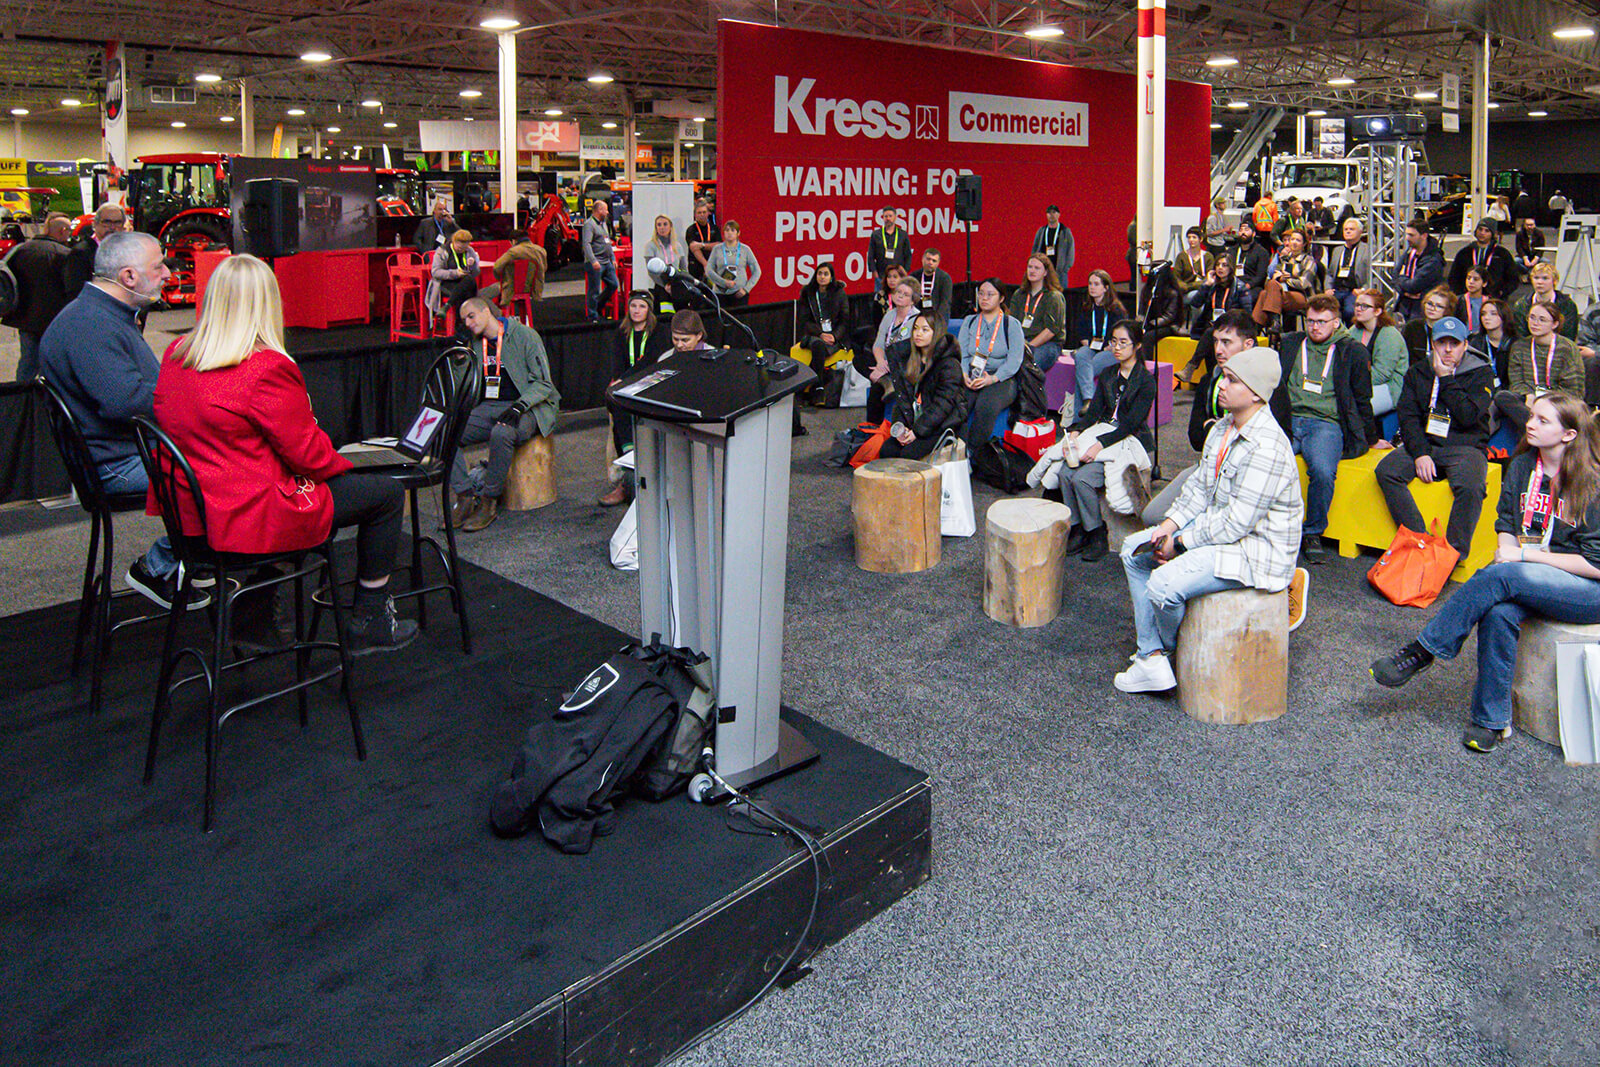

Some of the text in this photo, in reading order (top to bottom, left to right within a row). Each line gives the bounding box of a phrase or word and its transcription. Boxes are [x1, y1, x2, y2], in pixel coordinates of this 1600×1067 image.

[774, 75, 1082, 139] Kress Commercial
[774, 166, 974, 196] WARNING: FO
